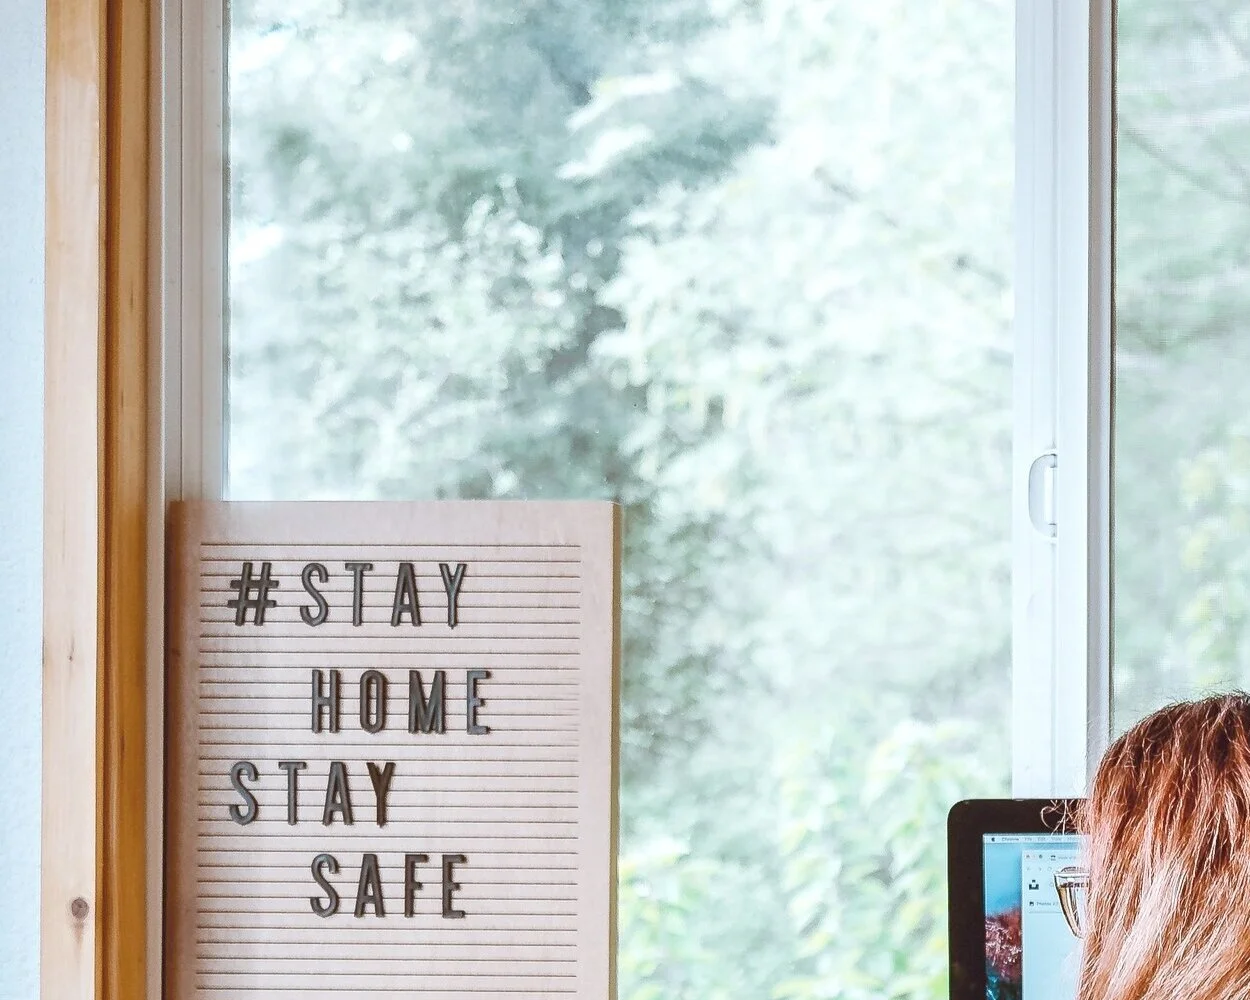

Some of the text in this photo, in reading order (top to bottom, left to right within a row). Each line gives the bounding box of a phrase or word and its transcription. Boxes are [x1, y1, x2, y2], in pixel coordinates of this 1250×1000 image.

[227, 562, 468, 629] #STAY
[311, 669, 491, 735] HOME
[228, 761, 396, 827] STAY
[310, 854, 468, 919] SAFE
